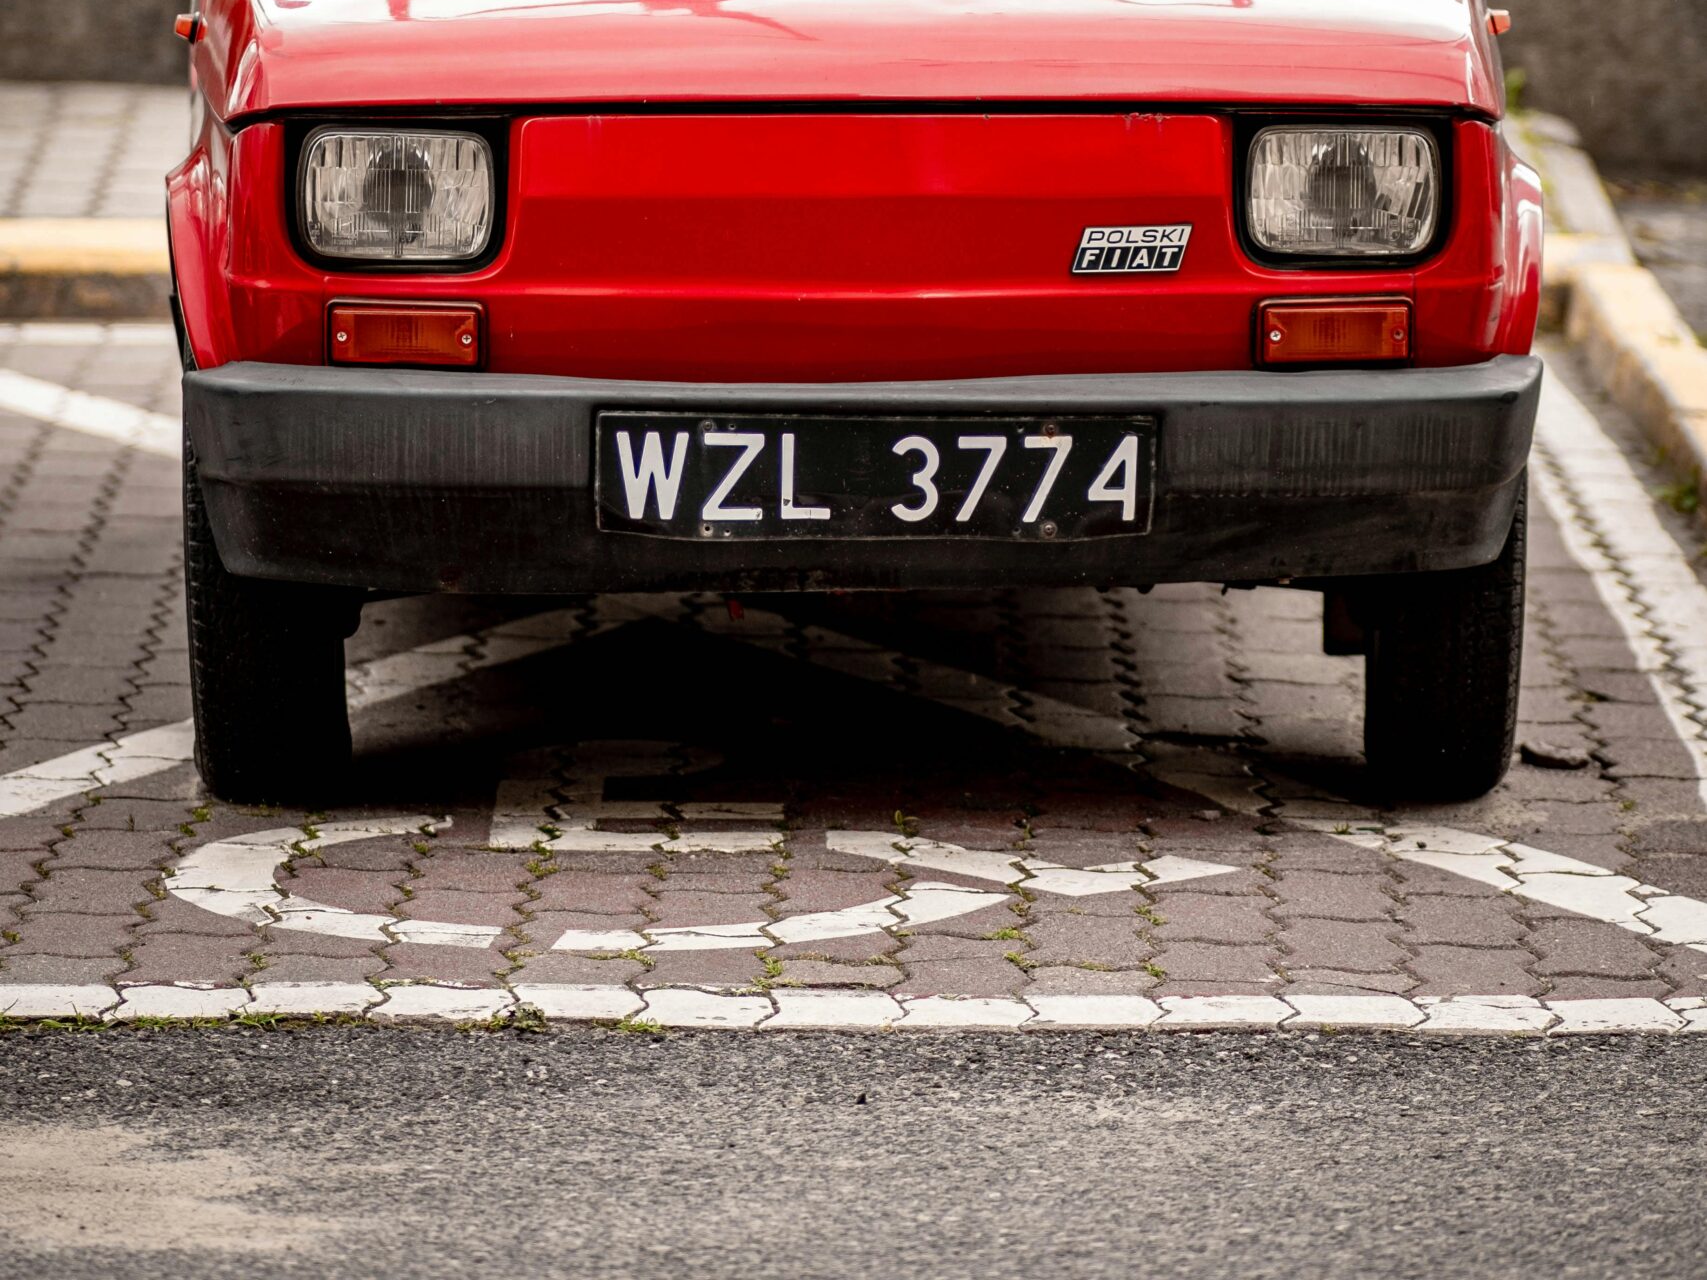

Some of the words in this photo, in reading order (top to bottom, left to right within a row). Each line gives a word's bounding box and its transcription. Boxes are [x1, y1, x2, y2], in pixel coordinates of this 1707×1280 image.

[1086, 228, 1185, 245] POLSKI
[1081, 247, 1179, 268] FIAT
[616, 431, 831, 521] WZL
[891, 435, 1139, 523] 3774
